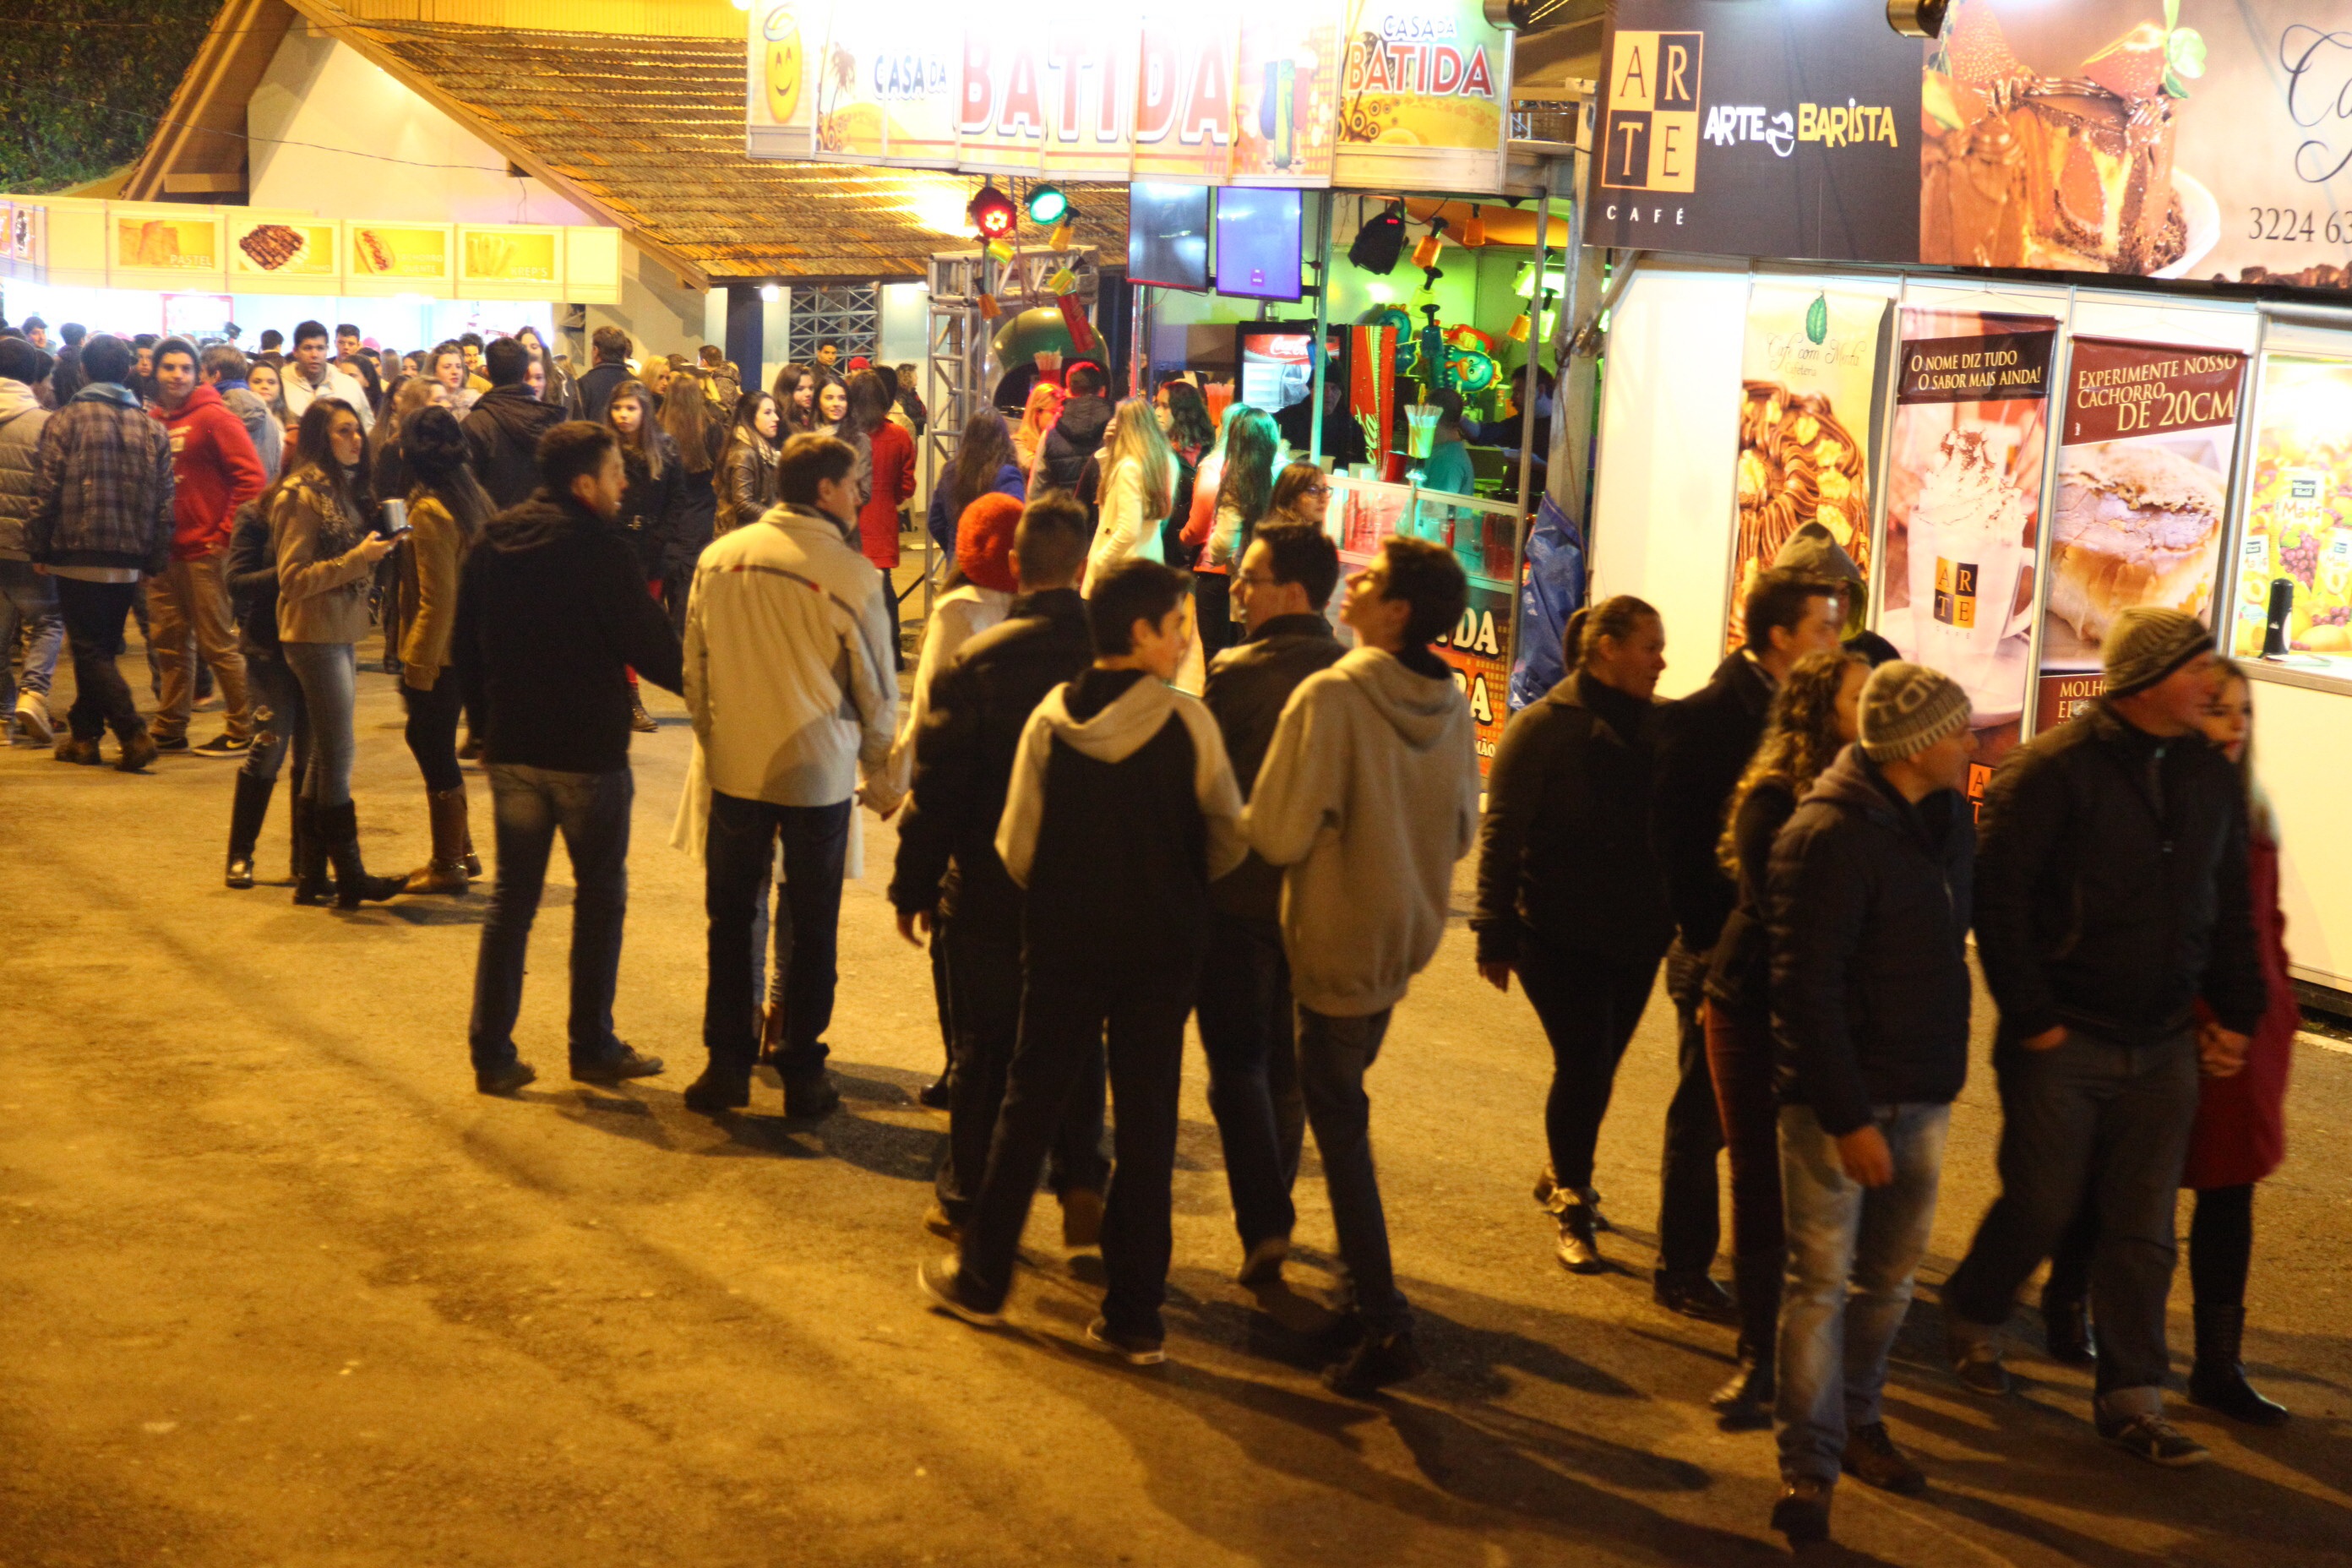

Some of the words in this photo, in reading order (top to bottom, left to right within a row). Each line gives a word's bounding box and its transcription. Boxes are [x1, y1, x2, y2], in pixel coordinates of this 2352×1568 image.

[1384, 15, 1434, 38] CASA
[1438, 20, 1455, 34] DA
[873, 52, 926, 97] CASA
[928, 59, 947, 91] DA
[955, 17, 1237, 145] BATIDA
[1348, 41, 1494, 97] BATIDA
[1703, 106, 1766, 146] ARTE
[1606, 205, 1685, 226] CAFÉ
[2248, 206, 2316, 243] 3224
[170, 254, 212, 266] PASTEL
[401, 264, 437, 274] QUENTE
[510, 266, 549, 278] KREP'S
[1798, 349, 1819, 360] com
[1911, 355, 1923, 372] O
[1925, 355, 1958, 371] NOME
[1962, 353, 1981, 368] DIZ
[1984, 350, 2017, 367] TUDO
[1918, 373, 1929, 390] O
[1932, 373, 1967, 389] SABOR
[1969, 371, 1995, 387] MAIS
[1999, 366, 2041, 385] AINDA!
[2078, 361, 2179, 389] EXPERIMENTE
[2183, 353, 2238, 376] NOSSO
[2077, 382, 2166, 409] CACHORRO
[2117, 400, 2152, 432] DE
[2159, 389, 2235, 427] 20CM
[1436, 607, 1500, 656] DA
